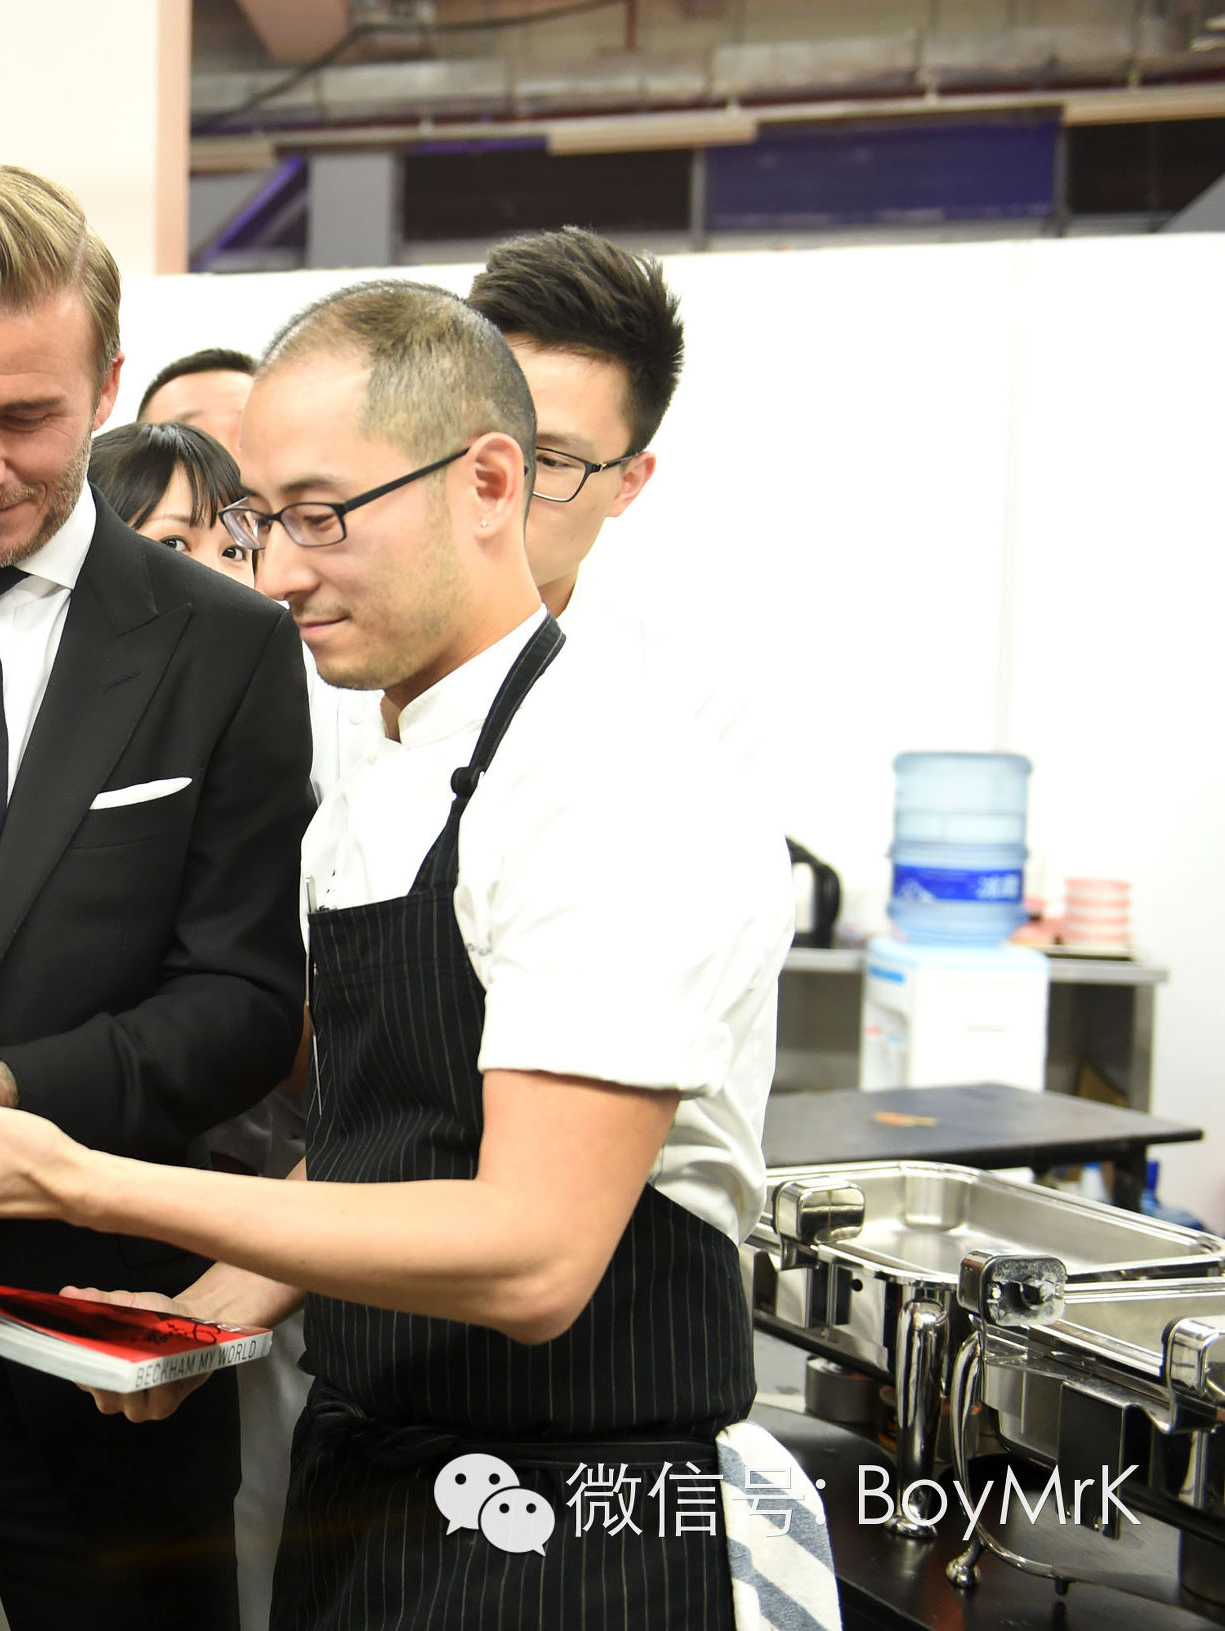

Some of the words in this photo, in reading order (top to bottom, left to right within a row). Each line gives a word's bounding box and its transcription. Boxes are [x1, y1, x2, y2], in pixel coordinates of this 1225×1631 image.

[136, 1355, 195, 1387] BECKHAM
[198, 1350, 215, 1371] MY
[218, 1340, 256, 1366] WORLD
